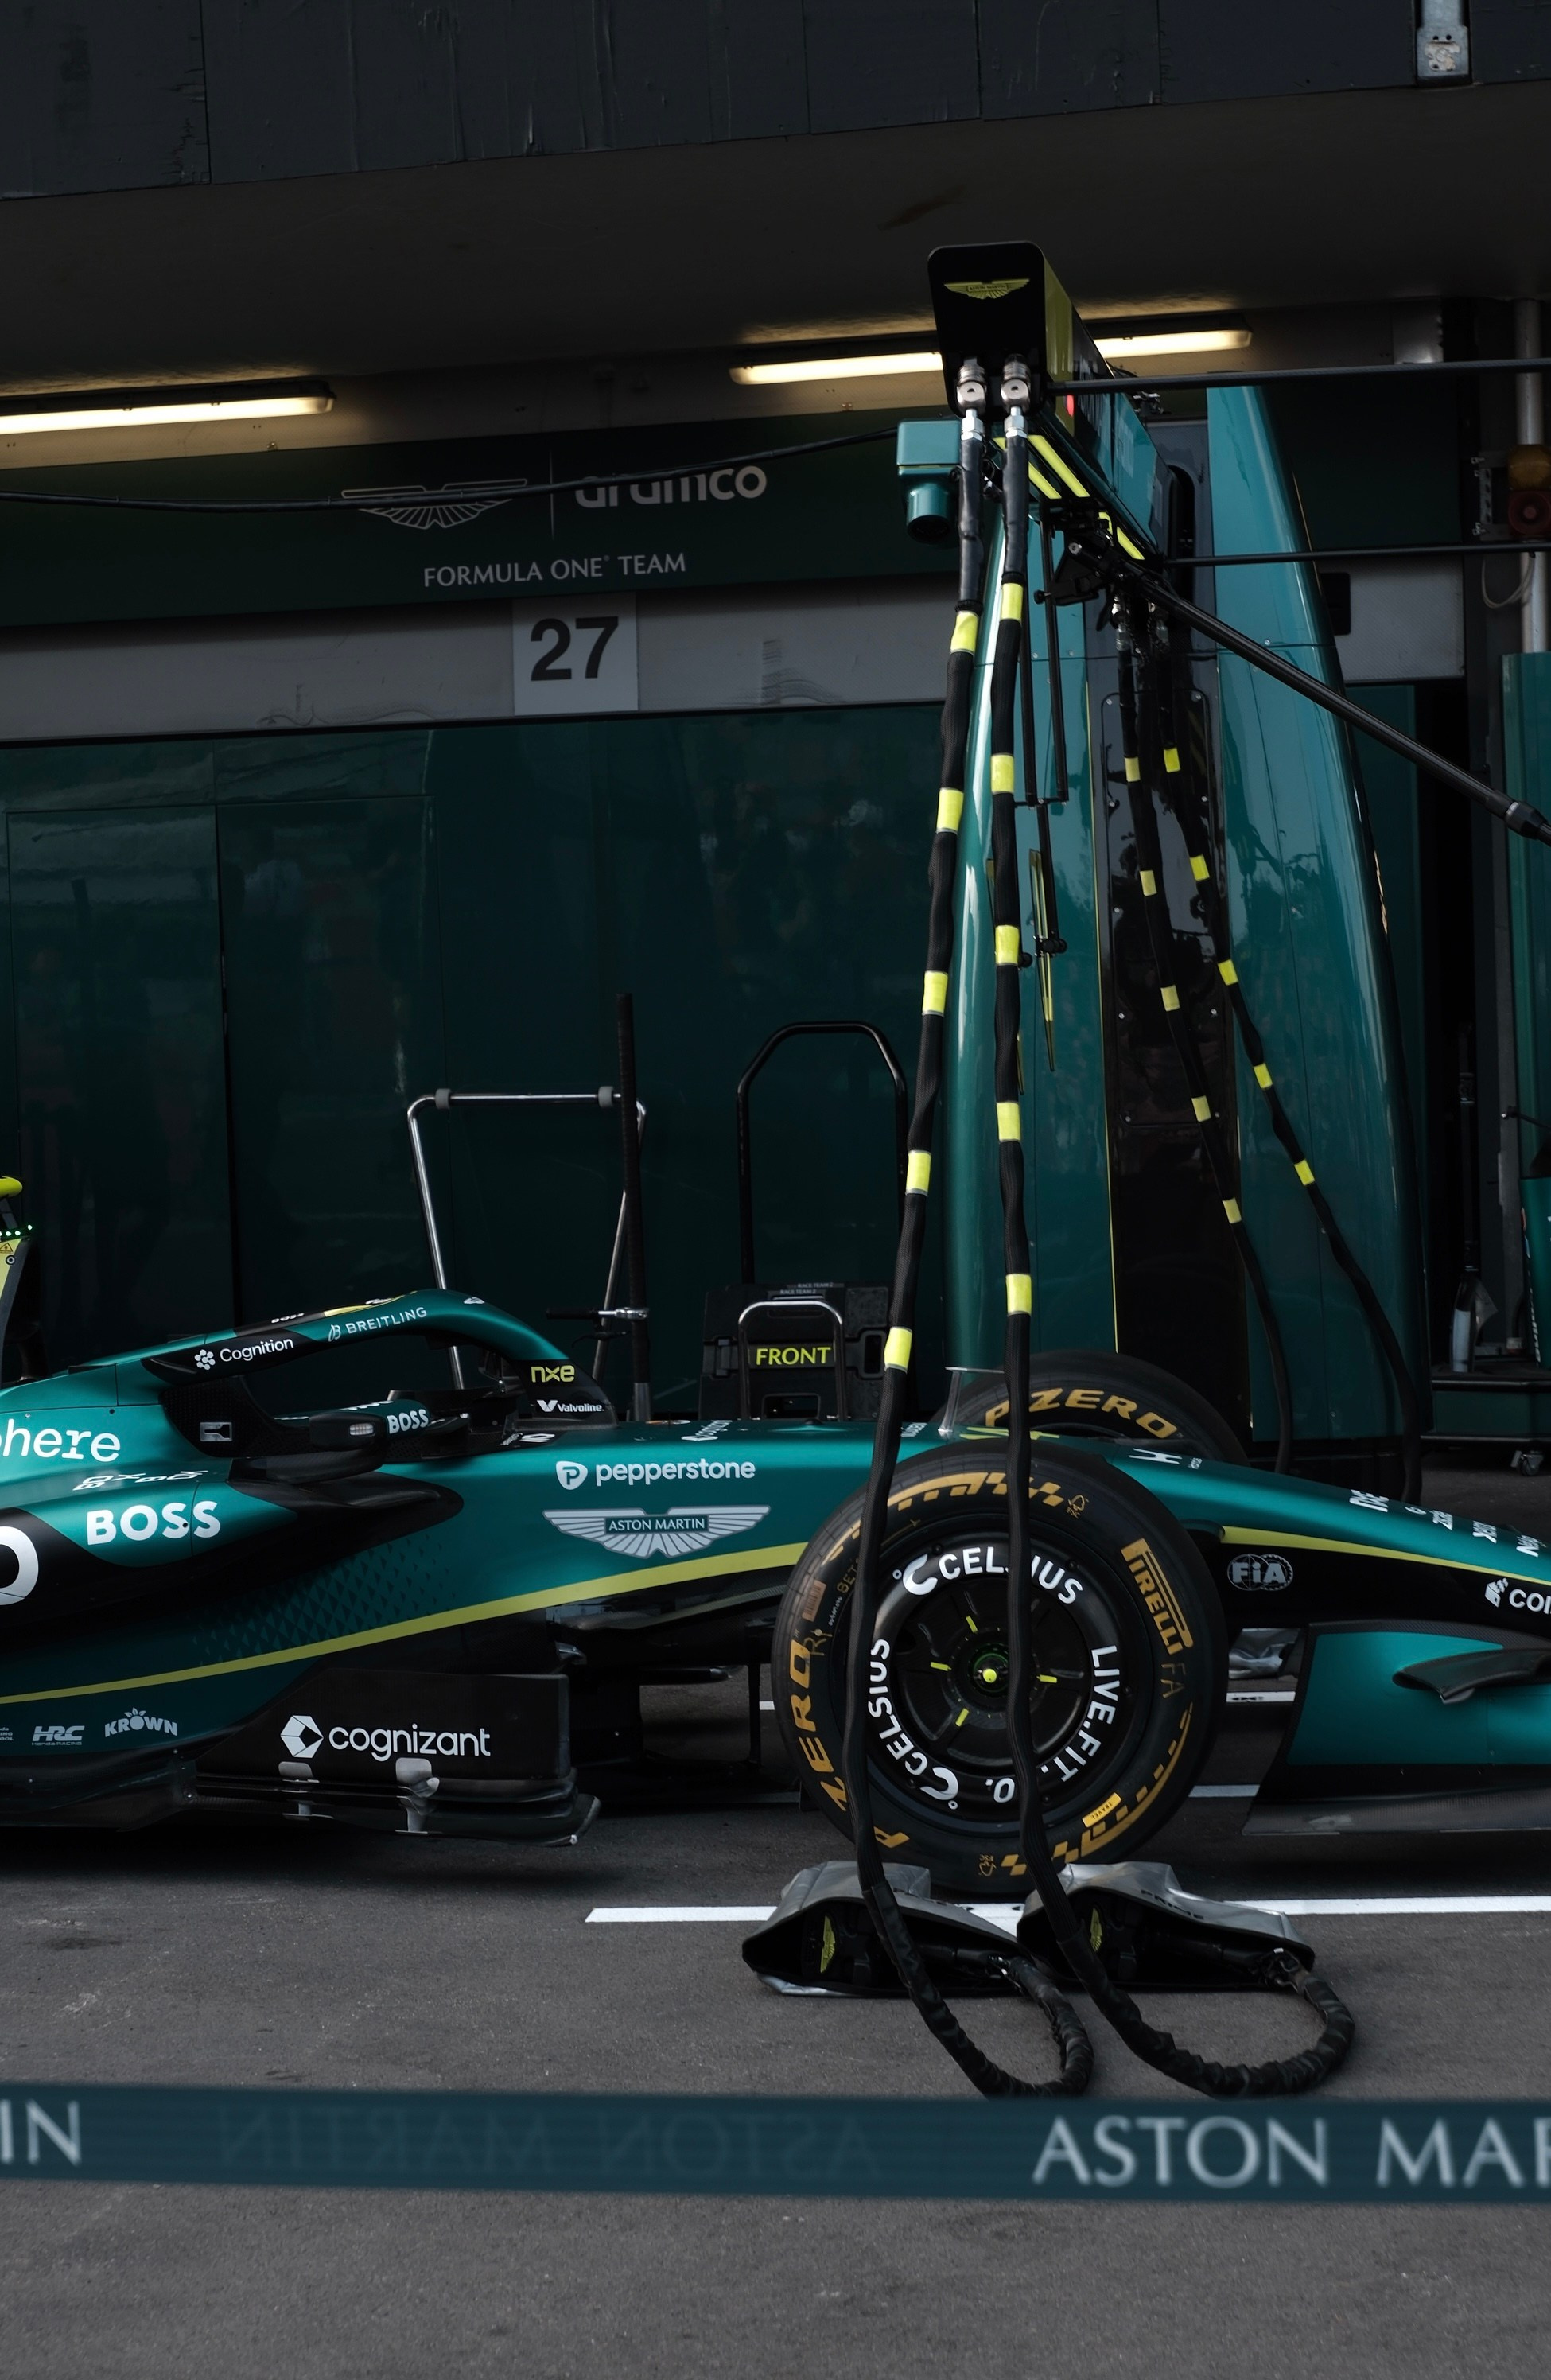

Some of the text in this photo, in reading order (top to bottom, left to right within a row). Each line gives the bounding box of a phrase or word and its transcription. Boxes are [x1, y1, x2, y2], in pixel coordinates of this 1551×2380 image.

[423, 559, 543, 588] FORMULA
[617, 552, 687, 577] TEAM
[530, 615, 620, 682] 27
[345, 1305, 428, 1335] BREITLING
[220, 1336, 295, 1363] Cognition
[756, 1346, 832, 1367] FRONT
[386, 1407, 430, 1435] BOSS
[1028, 1386, 1178, 1440] ZERO
[0, 1418, 121, 1463] here
[596, 1457, 756, 1487] pepperstone
[87, 1499, 221, 1546] BOSS
[608, 1517, 706, 1533] ASTON MARTIN
[938, 1546, 1084, 1605] CELIUS
[1120, 1537, 1194, 1656] PIRELLI
[104, 1715, 177, 1738] KROWN
[788, 1639, 848, 1812] ZERO
[867, 1639, 929, 1776] CELSIUS
[32, 1725, 86, 1742] HRC
[328, 1722, 492, 1763] cognizant
[1031, 2114, 1329, 2190] ASTON
